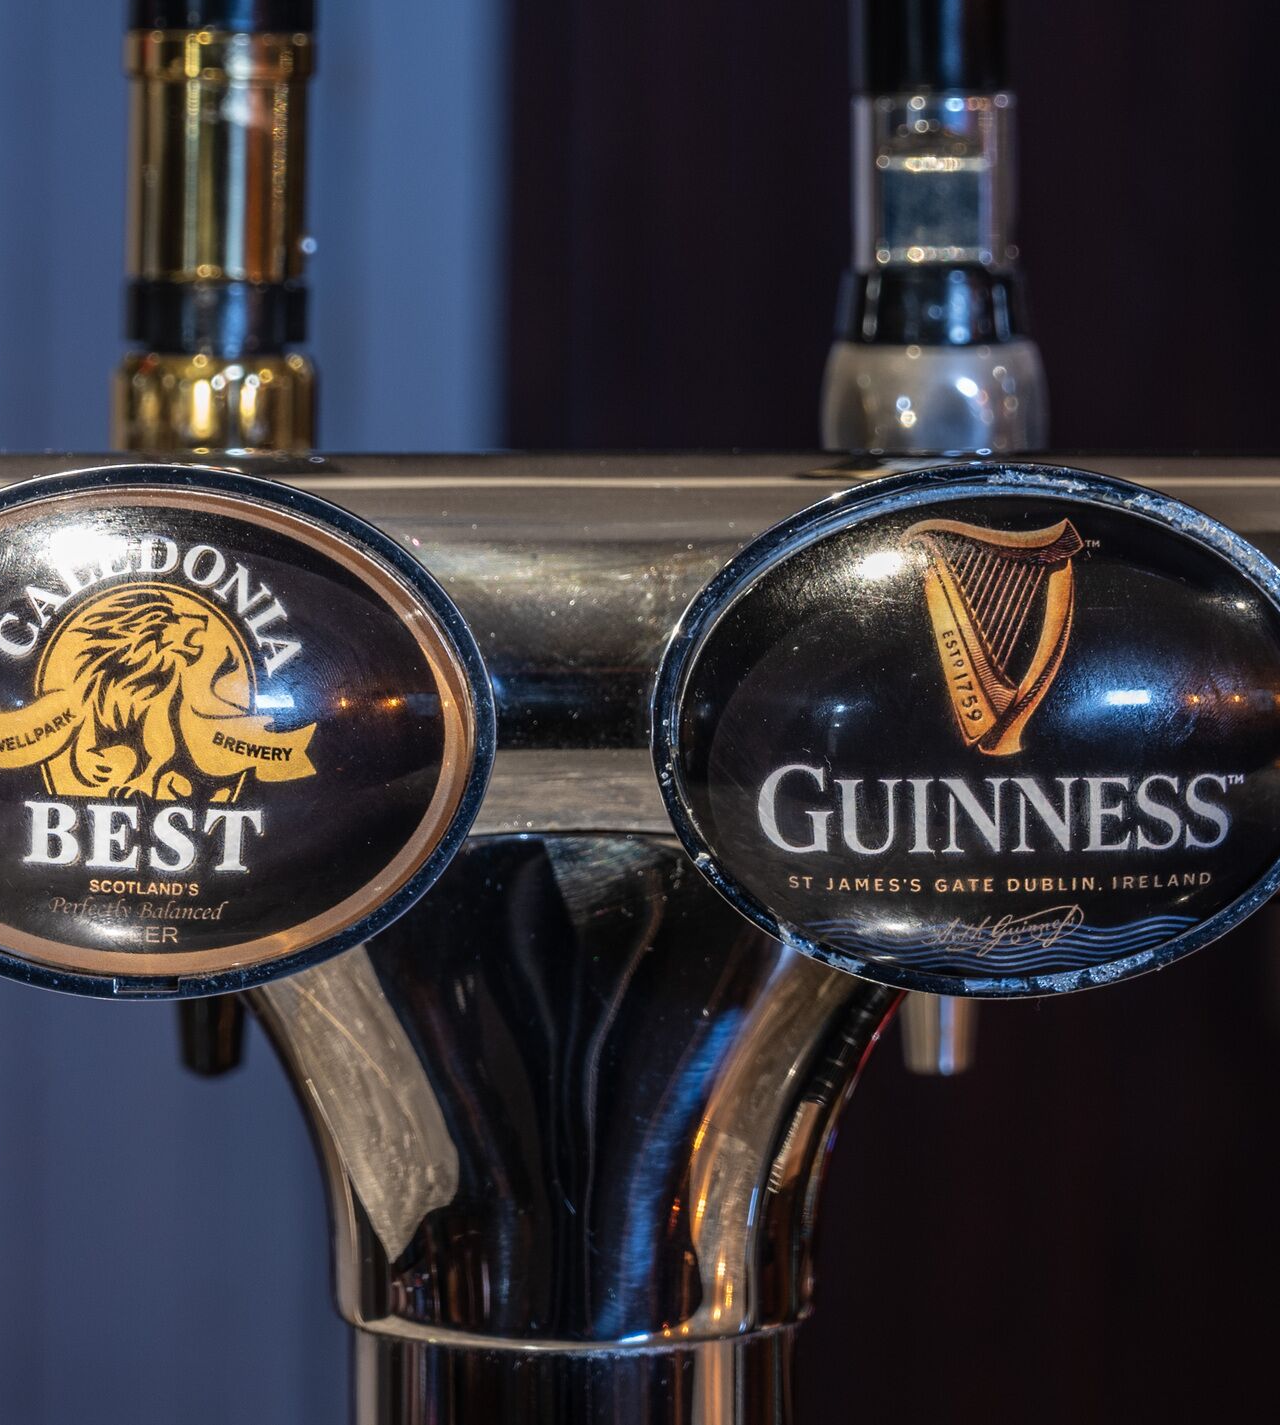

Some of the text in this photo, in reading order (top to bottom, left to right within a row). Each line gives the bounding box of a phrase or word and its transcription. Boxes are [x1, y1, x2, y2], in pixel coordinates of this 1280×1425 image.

[953, 672, 983, 722] 1759
[211, 731, 293, 762] BREWERY
[757, 763, 1232, 856] GUINNESS
[23, 800, 265, 873] BEST
[88, 879, 200, 897] SCOTLAND'S
[788, 875, 813, 890] ST
[826, 877, 922, 893] JAMES'S
[934, 877, 995, 893] GATE
[1111, 871, 1212, 891] IRELAND
[138, 899, 229, 921] Balanced
